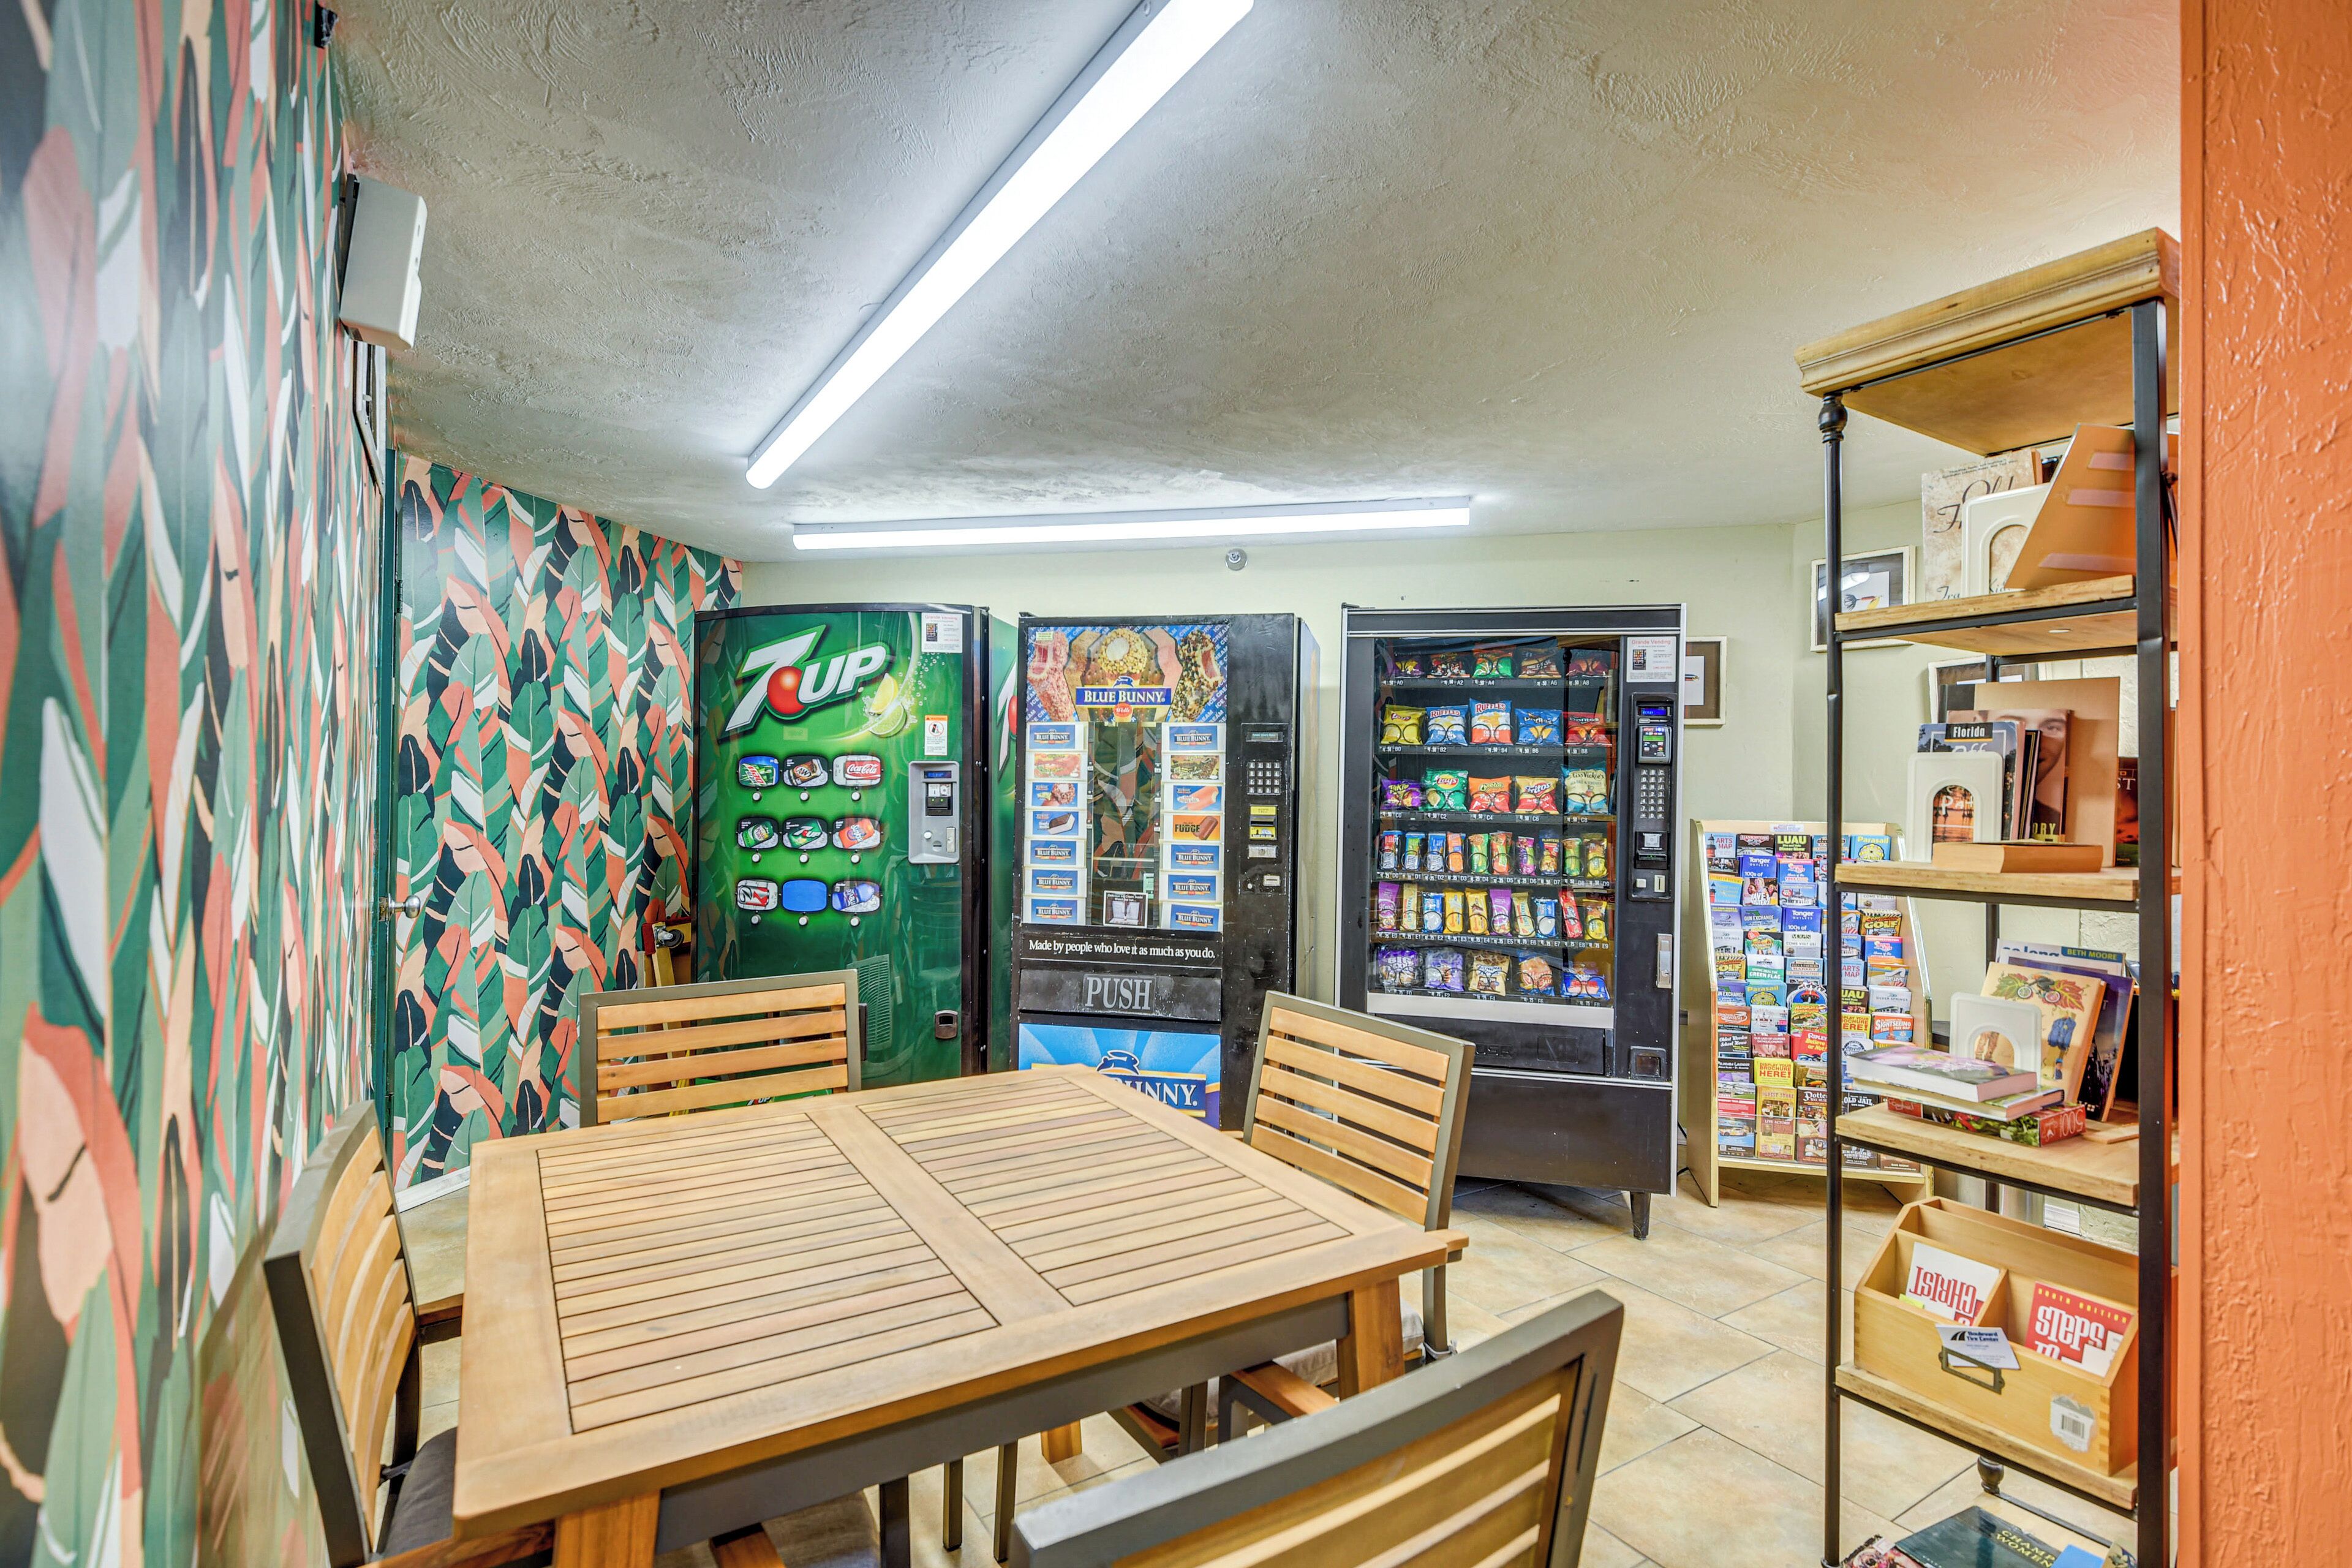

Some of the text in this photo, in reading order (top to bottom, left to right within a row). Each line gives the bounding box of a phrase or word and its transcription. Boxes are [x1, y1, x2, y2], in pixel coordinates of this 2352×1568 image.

[725, 630, 887, 731] 7UP
[1084, 690, 1116, 703] BLUE
[1476, 703, 1506, 714] RUFFLES
[1953, 726, 1985, 738] Florida
[1525, 782, 1551, 794] Fritos
[1175, 824, 1200, 833] FUDGE
[1777, 835, 1807, 845] LUAU
[1864, 920, 1898, 929] GOLF
[1029, 940, 1216, 960] Made by people who love it as much as you do.
[2067, 948, 2087, 957] BETH
[2087, 951, 2118, 960] MOORE
[1085, 976, 1153, 1010] PUSH
[1841, 989, 1865, 998] UAU
[1807, 1033, 1827, 1041] RIPLEY
[1909, 1265, 1977, 1315] CHRIST
[2002, 1530, 2056, 1562] CHAMP
